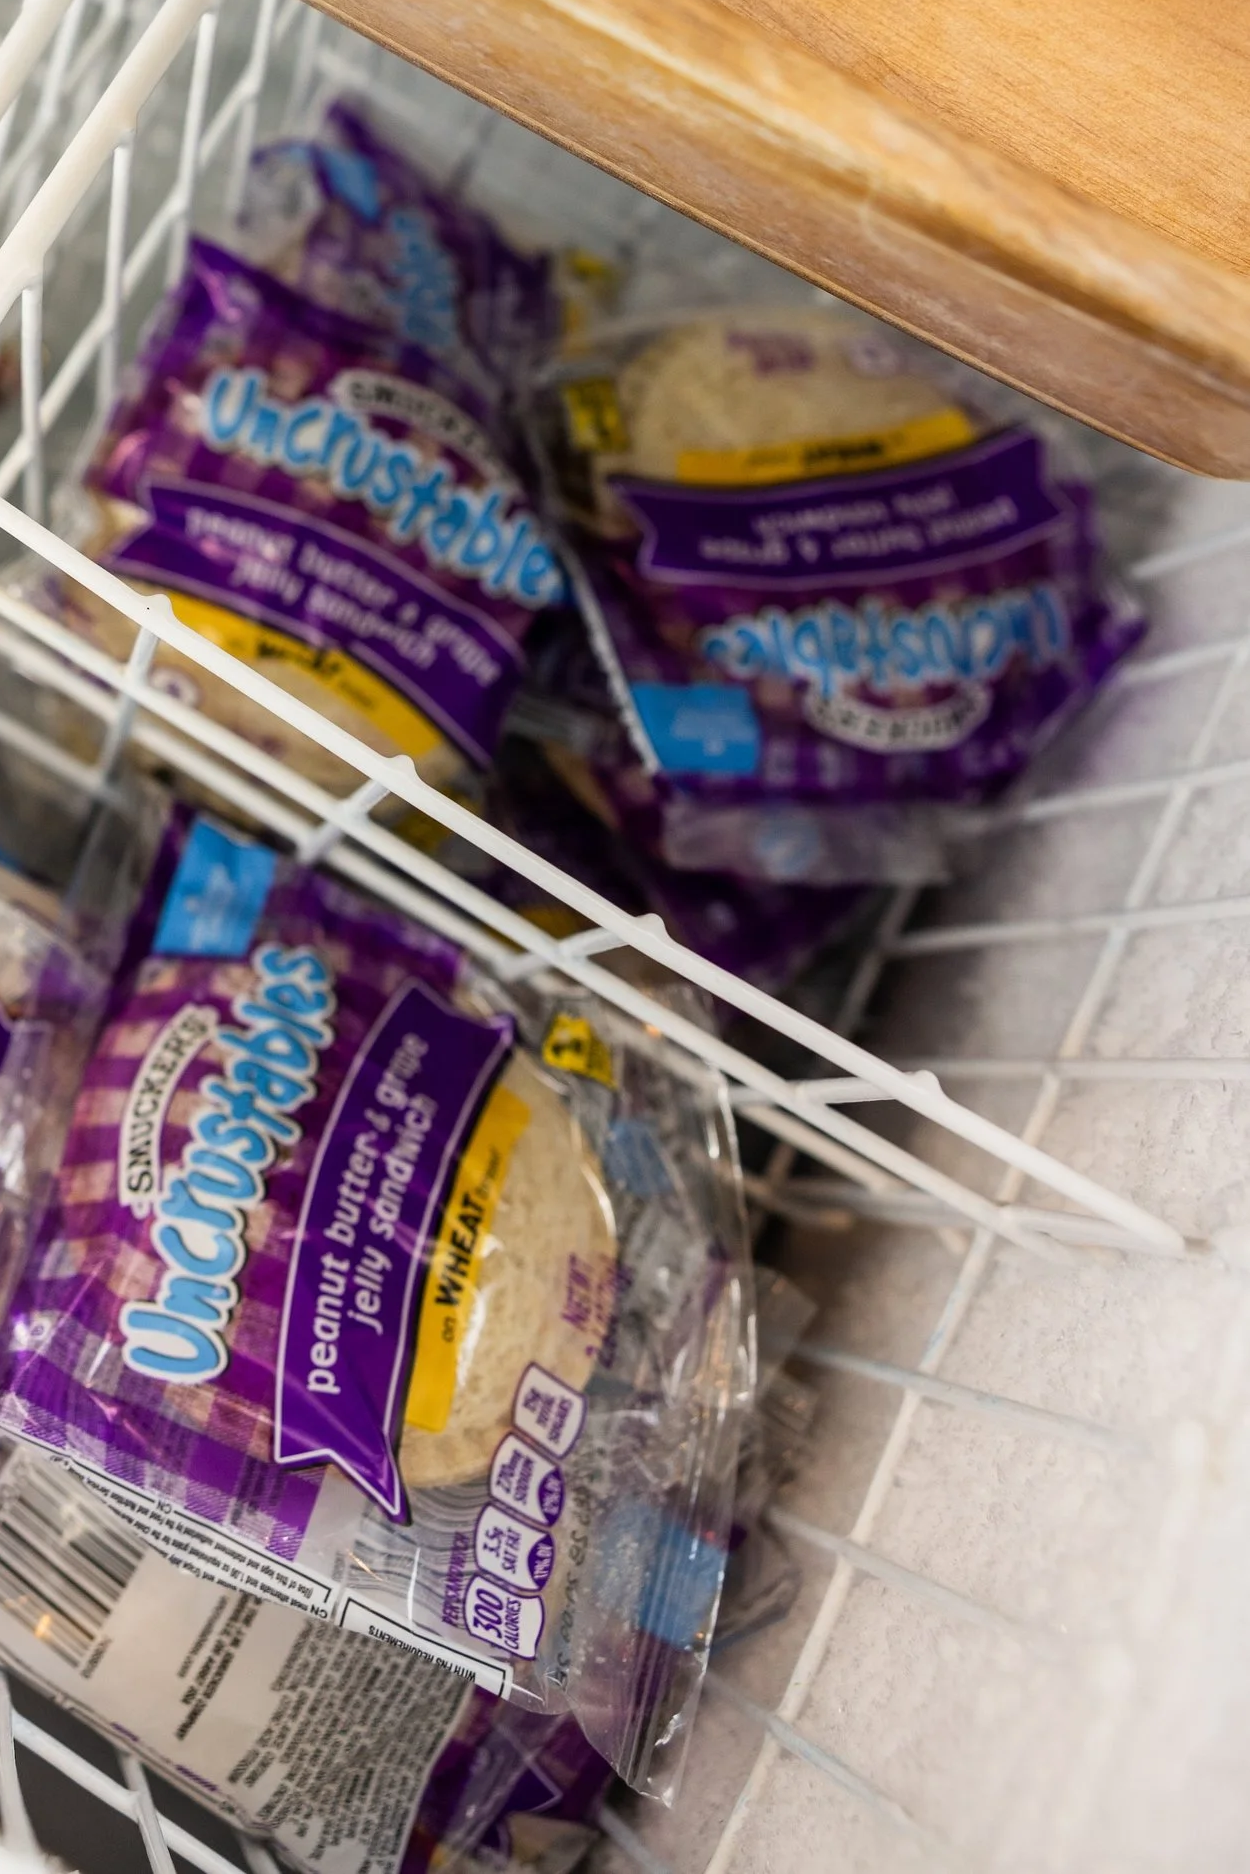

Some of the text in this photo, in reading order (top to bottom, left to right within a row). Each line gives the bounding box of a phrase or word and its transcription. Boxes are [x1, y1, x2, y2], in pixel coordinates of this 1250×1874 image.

[375, 1032, 429, 1110] grape
[123, 944, 333, 1379] Uncrustables
[323, 1130, 380, 1248] butter
[347, 1093, 438, 1335] jelly sandwich
[434, 1193, 486, 1306] WHEAT
[306, 1252, 351, 1395] peanut
[110, 1492, 136, 1510] Nutrition
[136, 1505, 149, 1516] and
[157, 1500, 172, 1515] CN
[149, 1510, 164, 1525] Food
[165, 1518, 175, 1529] the
[151, 1529, 162, 1540] the
[161, 1534, 171, 1545] for
[483, 1526, 506, 1558] 3.5g
[214, 1542, 247, 1563] statement
[502, 1528, 523, 1574] SAT FAT
[246, 1558, 260, 1569] and
[447, 1531, 471, 1603] SANDWICH
[245, 1575, 259, 1587] and
[287, 1578, 298, 1589] of
[310, 1603, 328, 1619] CN
[473, 1588, 505, 1639] 300
[504, 1597, 522, 1650] CALORIES
[368, 1625, 434, 1662] REQUIREMENTS
[453, 1668, 477, 1683] WITH
